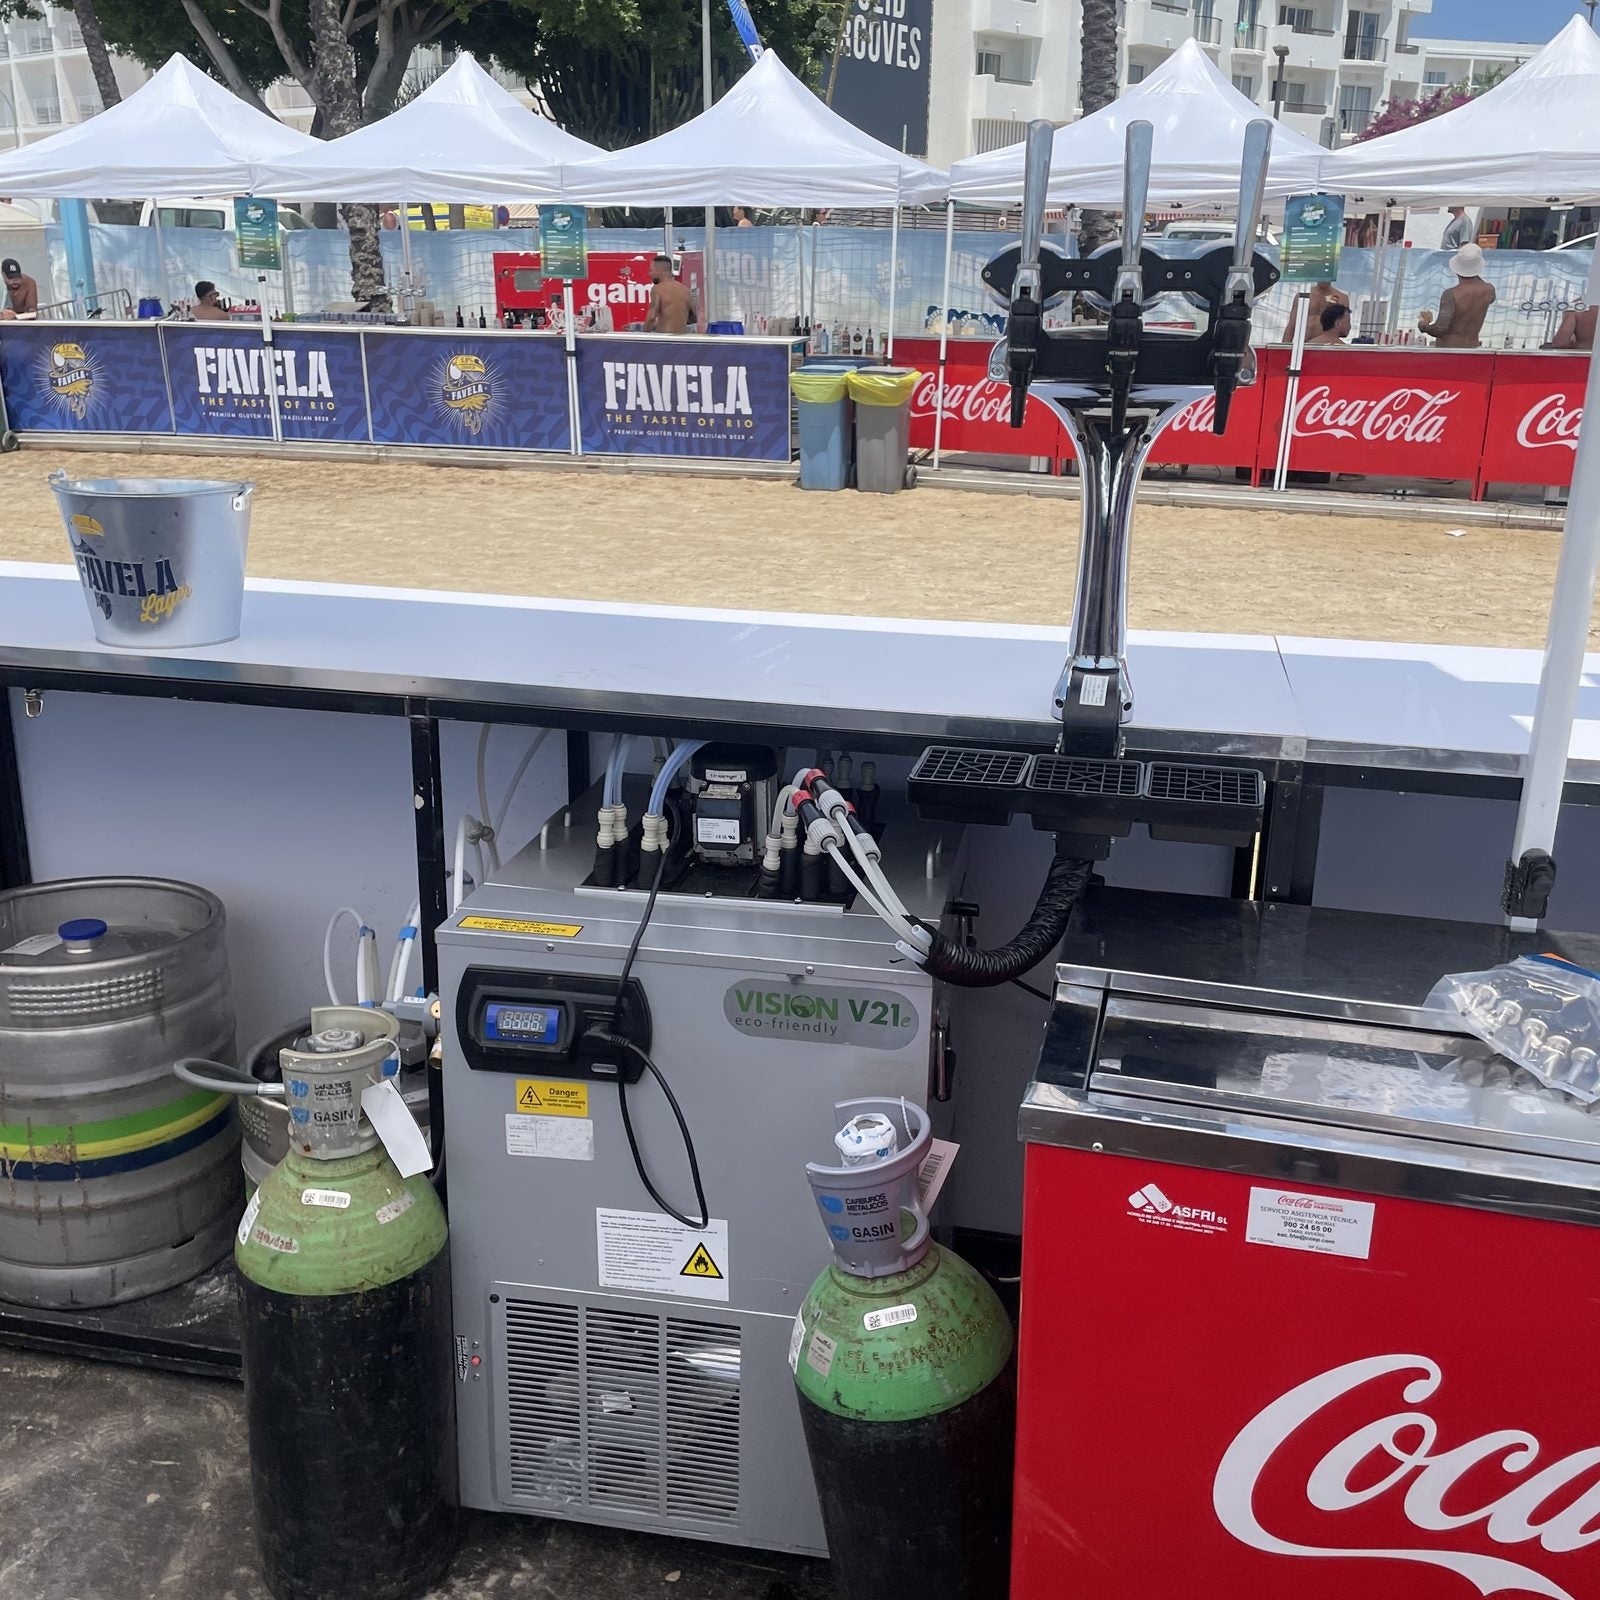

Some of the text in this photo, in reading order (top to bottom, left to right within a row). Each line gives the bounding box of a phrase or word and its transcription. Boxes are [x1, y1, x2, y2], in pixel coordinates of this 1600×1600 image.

[587, 283, 652, 308] gam
[57, 370, 86, 387] FAVELA
[194, 347, 334, 398] FAVELA
[451, 384, 484, 401] FAVELA
[603, 362, 753, 415] FAVELA
[910, 371, 1028, 424] Coca-Col
[200, 397, 335, 411] THE TAST OF RIO
[606, 413, 754, 429] THE TASTE OF RIO
[1292, 385, 1462, 443] Coca-Cola
[614, 428, 746, 442] PREMIUM GLUTEN FREE BRAZILIAN BEER
[74, 553, 179, 598] FAVELA
[139, 584, 193, 624] Lager
[735, 989, 838, 1021] VISION
[735, 1017, 838, 1037] eco-friendly
[549, 1088, 579, 1098] Danger
[314, 1109, 354, 1122] GASIN
[845, 1193, 886, 1205] CARBUROS
[1171, 1205, 1216, 1223] ASFRI
[1260, 1205, 1358, 1225] SERVICIO ASISTENCIA TÉCNICA
[852, 1222, 895, 1238] GASIN
[1283, 1221, 1298, 1229] 900
